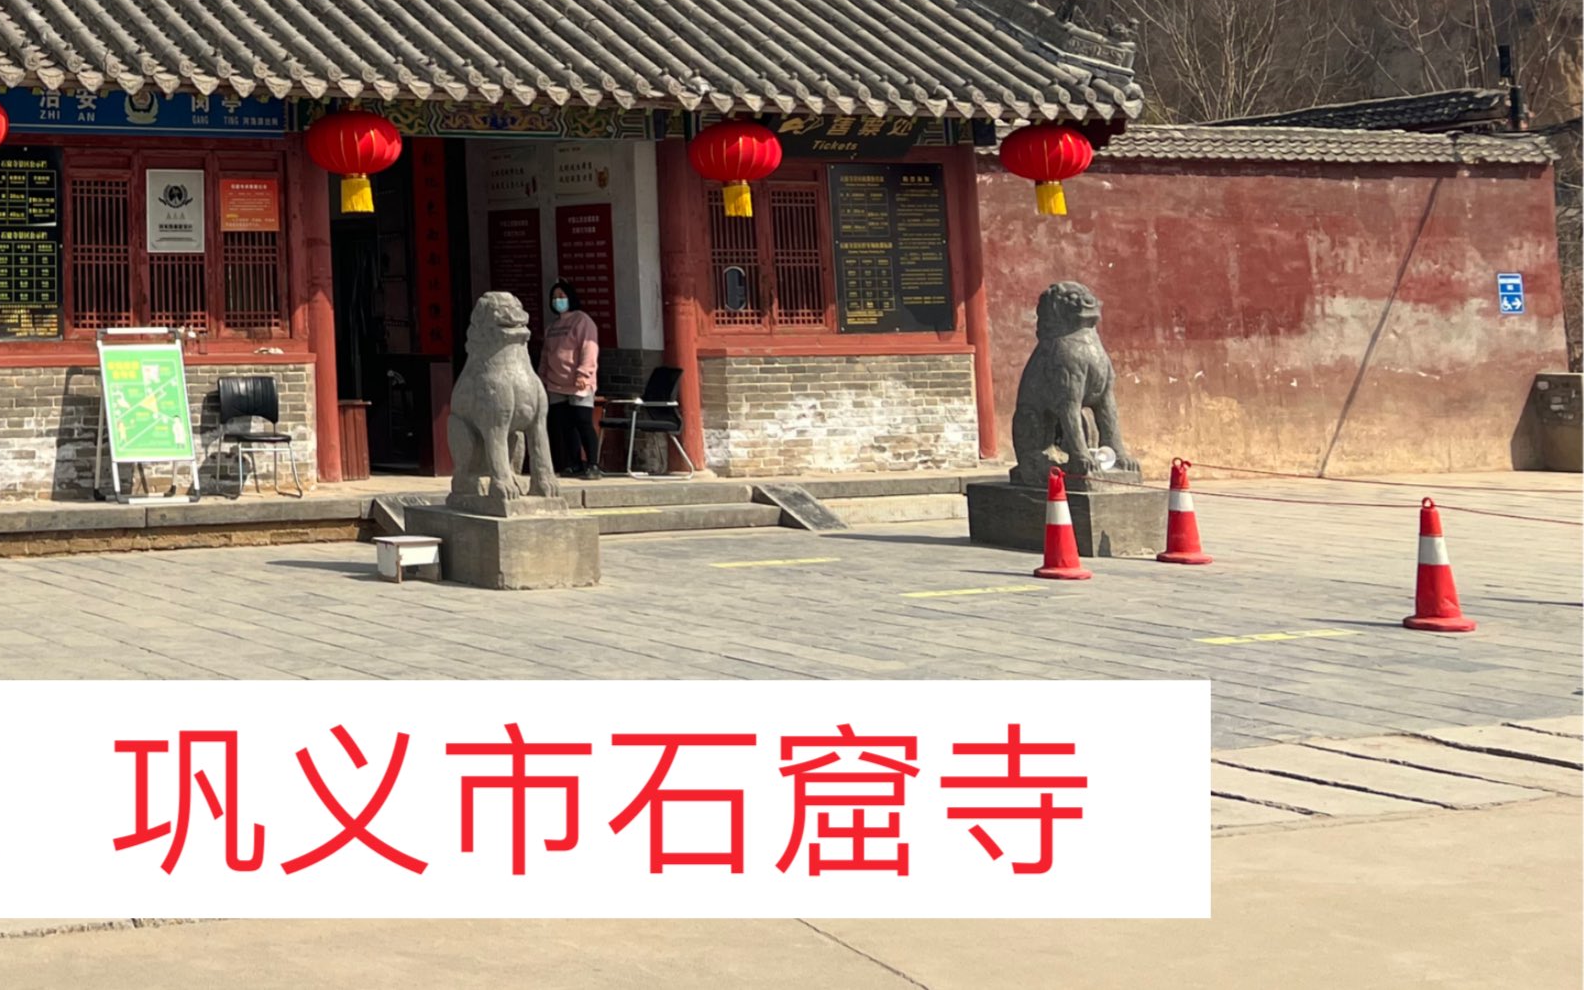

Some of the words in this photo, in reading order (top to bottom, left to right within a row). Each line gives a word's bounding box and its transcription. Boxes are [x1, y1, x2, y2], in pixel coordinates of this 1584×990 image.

[39, 110, 61, 120] ZHI
[77, 112, 96, 122] AN
[826, 116, 913, 136] 售票处
[812, 139, 859, 151] Tickets
